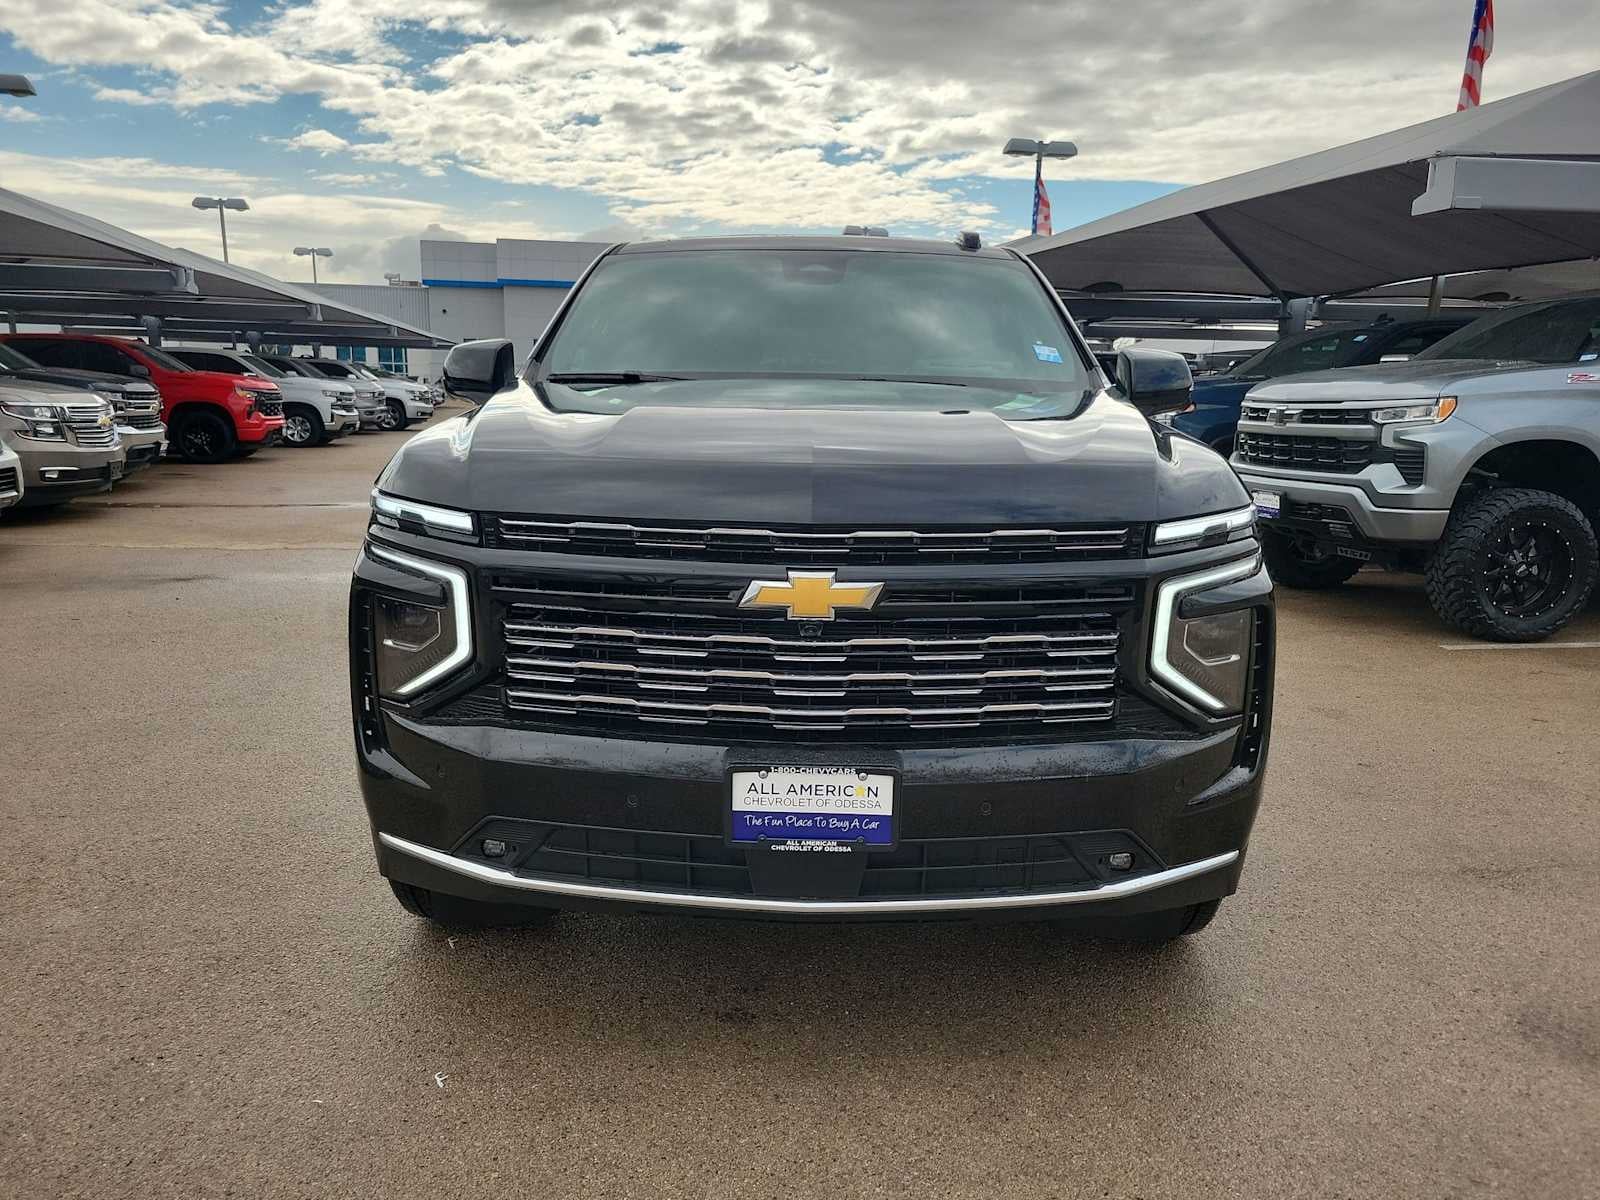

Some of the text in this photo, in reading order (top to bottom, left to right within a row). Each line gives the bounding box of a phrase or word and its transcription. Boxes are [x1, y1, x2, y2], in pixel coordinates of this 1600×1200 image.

[747, 782, 879, 798] ALL AMERICN
[743, 797, 882, 809] CHEVROLET OF ODESSA
[744, 815, 880, 831] The Fun Place To Buy A Car
